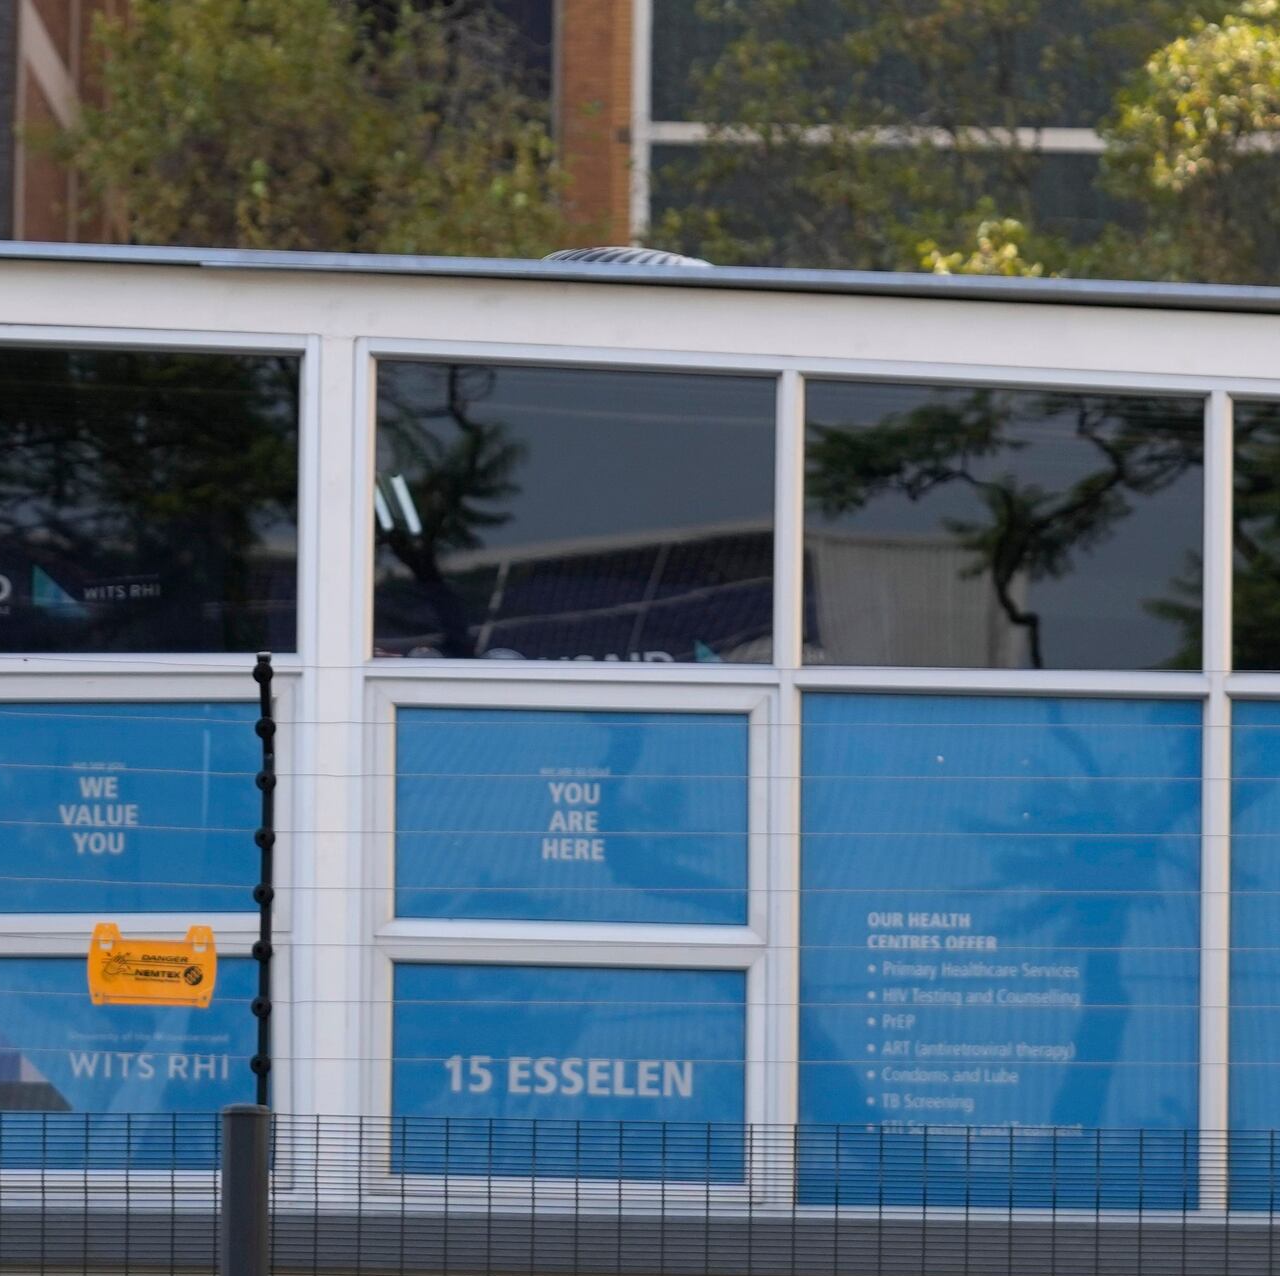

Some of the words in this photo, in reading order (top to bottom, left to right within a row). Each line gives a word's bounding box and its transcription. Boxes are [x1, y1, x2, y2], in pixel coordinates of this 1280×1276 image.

[84, 584, 126, 600] WITS
[129, 583, 161, 598] RHI
[79, 776, 118, 799] WE
[548, 782, 601, 804] YOU
[59, 804, 139, 826] VALUE
[548, 810, 599, 833] ARE
[73, 832, 124, 855] YOU
[542, 838, 605, 861] HERE
[867, 911, 903, 928] OUR
[908, 912, 971, 929] HEALTH
[867, 934, 941, 949] CENTRES
[945, 935, 998, 950] OFFER
[141, 954, 189, 963] DANGER
[135, 968, 181, 979] NEMTEK
[882, 961, 937, 981] Primary
[69, 1052, 155, 1079] WITS
[167, 1054, 229, 1080] RHI
[443, 1054, 493, 1092] 15
[507, 1056, 694, 1097] ESSELEN
